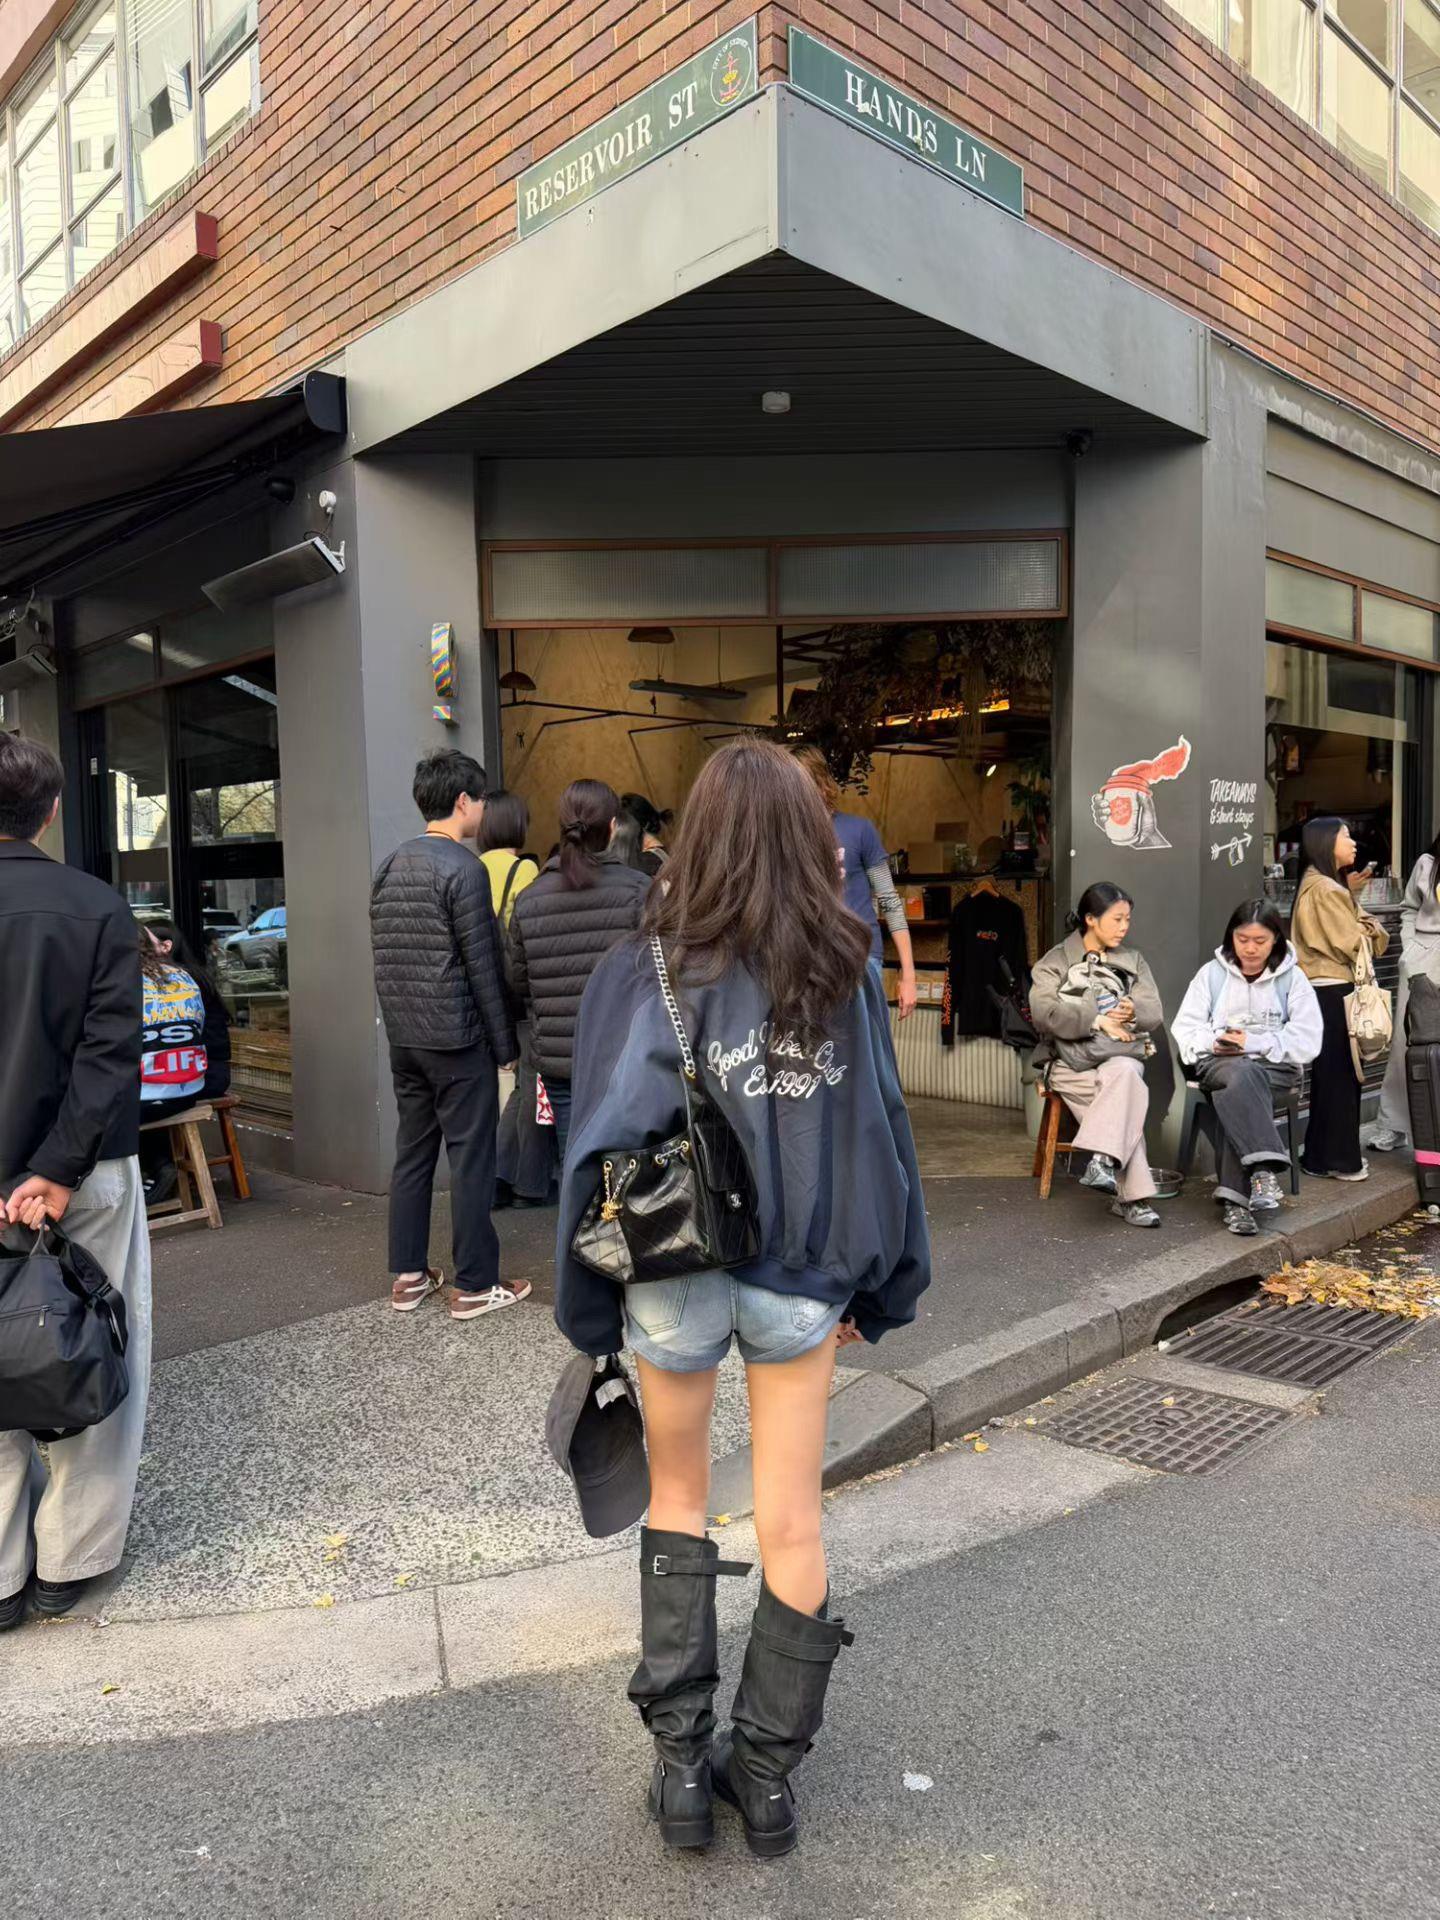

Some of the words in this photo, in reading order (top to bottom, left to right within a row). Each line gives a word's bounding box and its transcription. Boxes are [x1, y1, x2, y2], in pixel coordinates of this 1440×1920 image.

[524, 113, 653, 221] RESERVOIR
[668, 81, 698, 130] ST
[845, 69, 938, 154] HANDS
[955, 136, 987, 182] LN
[1210, 778, 1257, 804] TAKEAWAYS
[707, 1028, 758, 1092] Good
[767, 1070, 822, 1099] 1991
